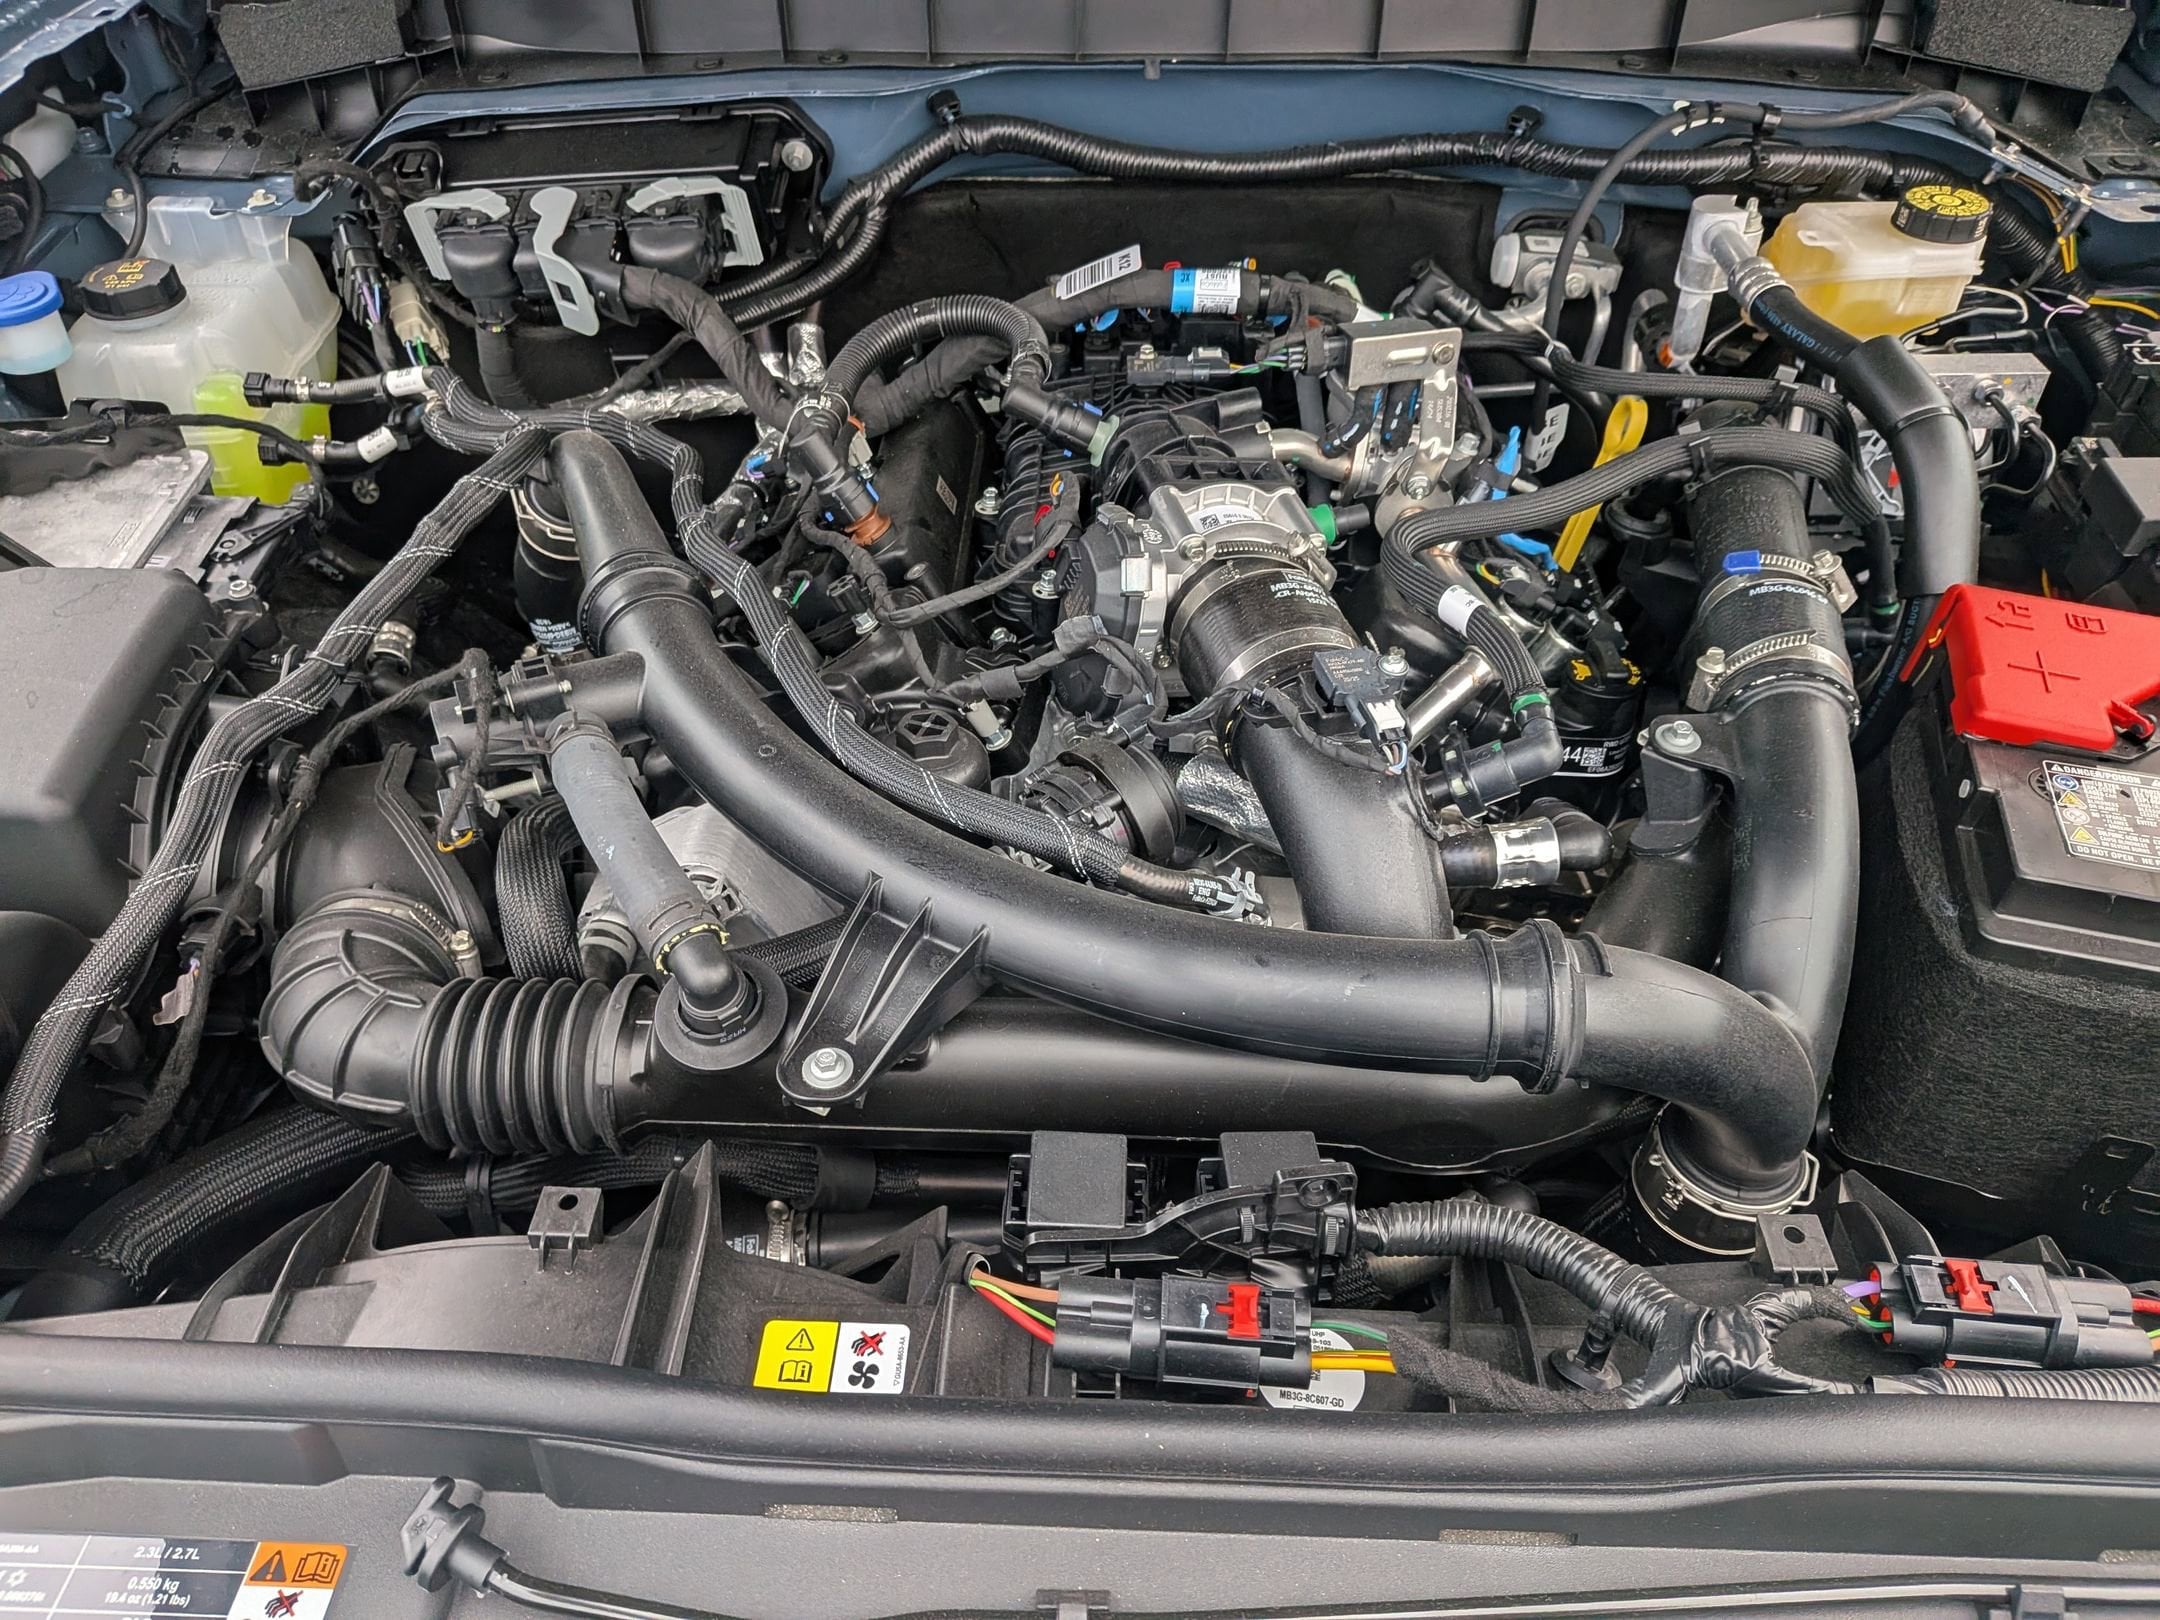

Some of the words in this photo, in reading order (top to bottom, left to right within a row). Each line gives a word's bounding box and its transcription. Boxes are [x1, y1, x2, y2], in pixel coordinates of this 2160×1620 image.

[1118, 253, 1131, 272] K12
[1780, 322, 1816, 348] GALAXY
[2064, 766, 2142, 784] DANGER/POISON
[2091, 848, 2109, 857] NOT
[2111, 851, 2138, 863] OPEN.
[1279, 1390, 1345, 1408] MB3G-8C607-GD
[134, 1546, 162, 1559] 2.3L
[164, 1547, 173, 1559] /
[172, 1548, 200, 1560] 2.7L
[127, 1576, 162, 1590] 0.550
[162, 1578, 180, 1594] kg
[127, 1595, 142, 1605] oz
[141, 1594, 168, 1607] (1.21
[168, 1594, 191, 1608] lbs)
